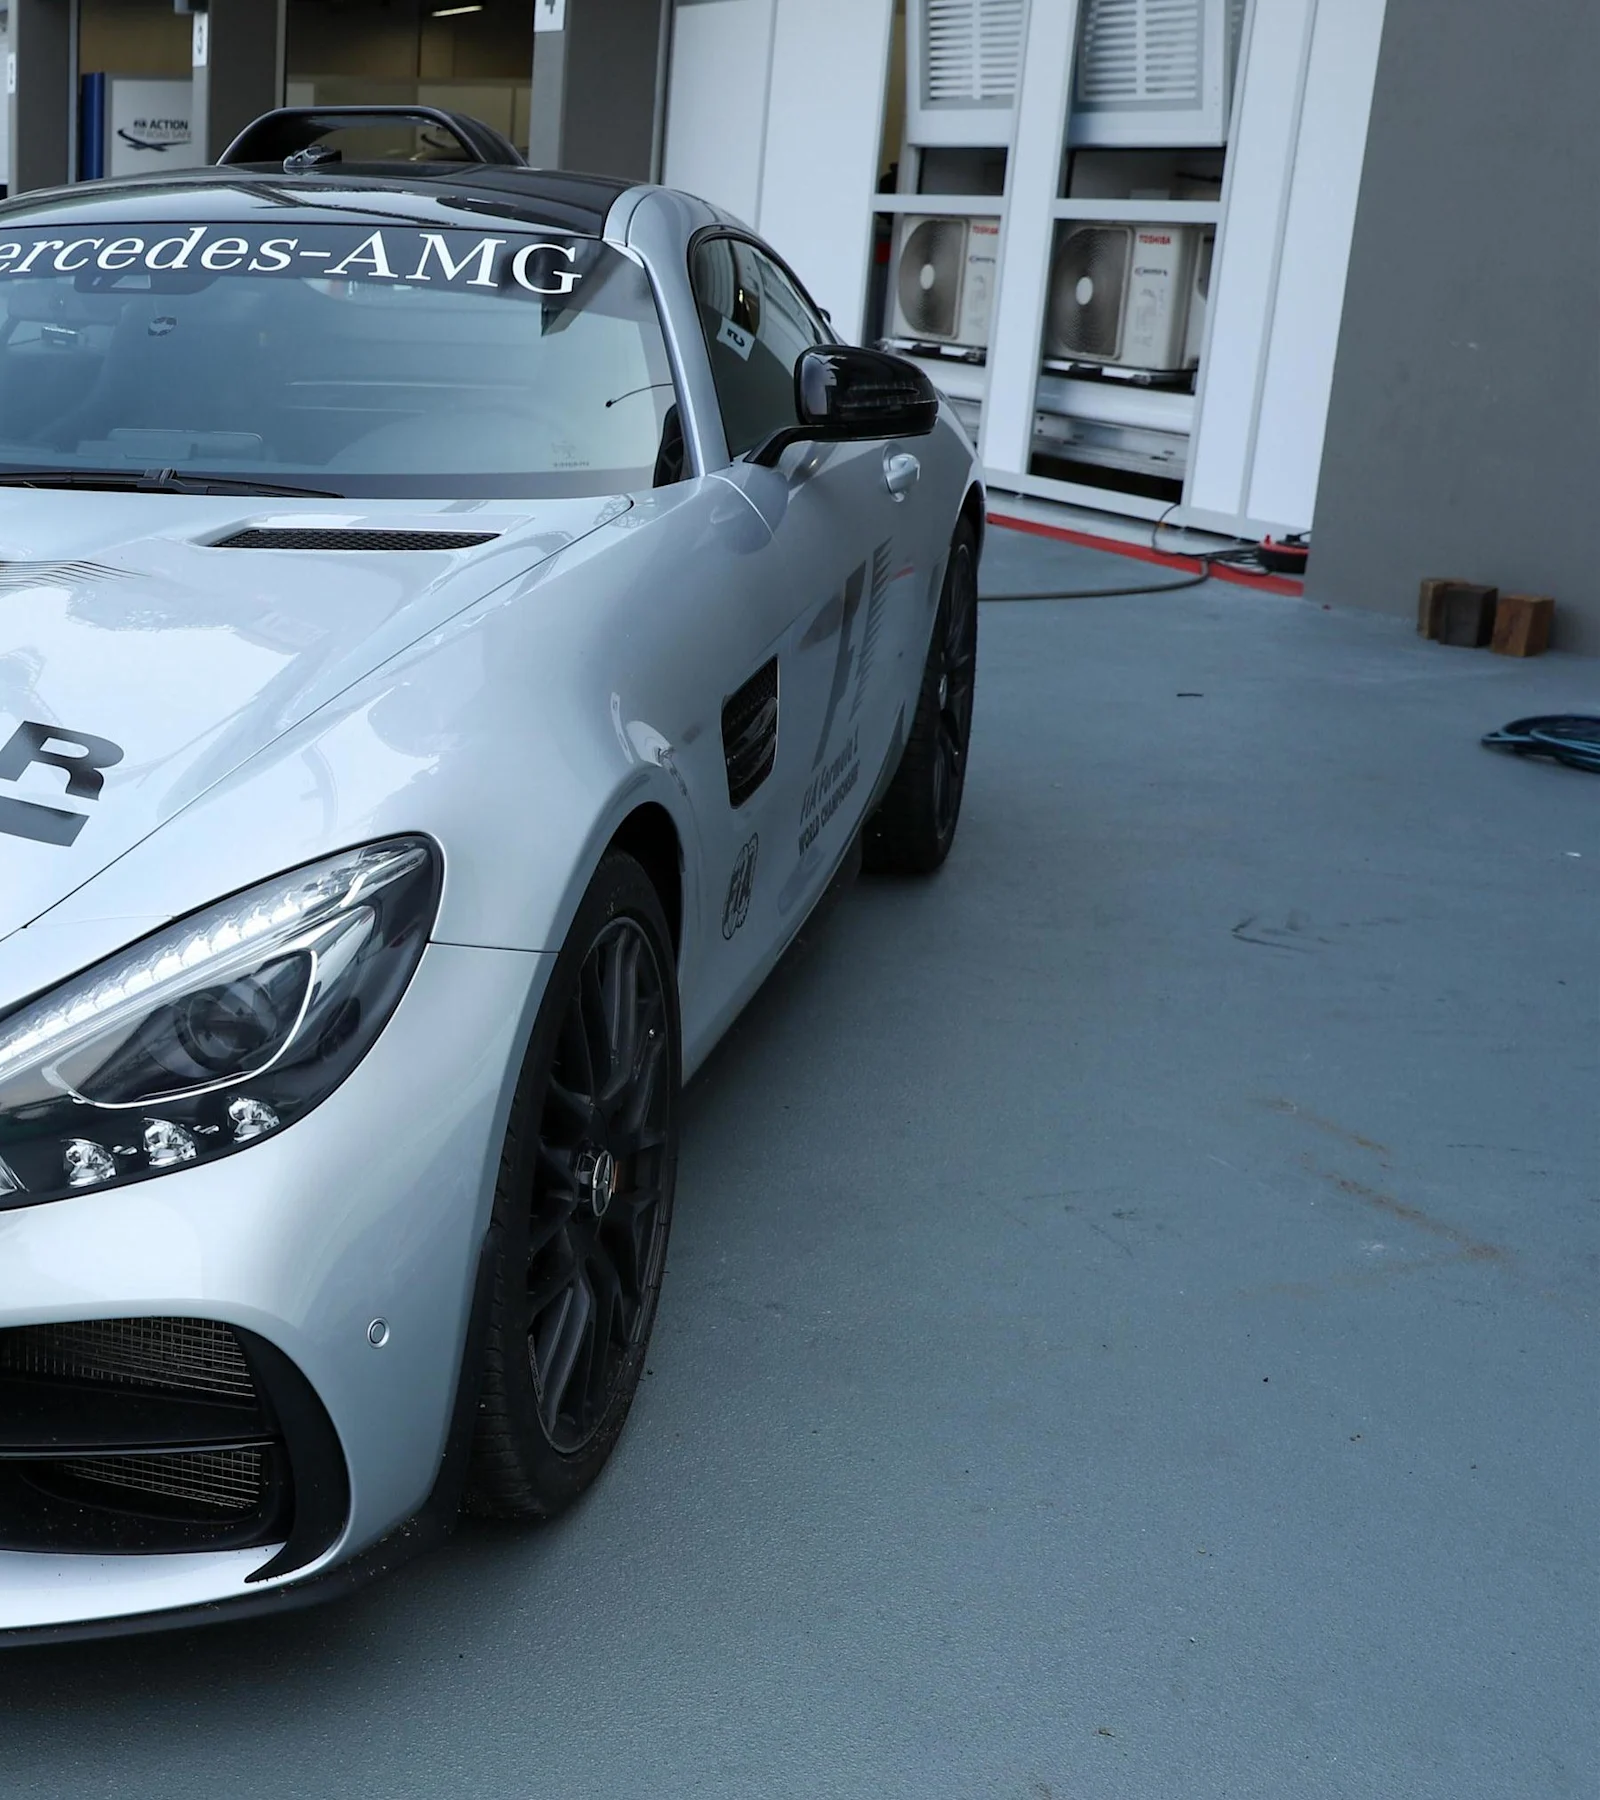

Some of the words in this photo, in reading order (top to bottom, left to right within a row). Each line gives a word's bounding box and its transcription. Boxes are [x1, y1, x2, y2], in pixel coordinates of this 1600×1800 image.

[149, 119, 188, 130] ACTION
[1138, 233, 1171, 245] TOSHIBA
[818, 736, 854, 798] Formula
